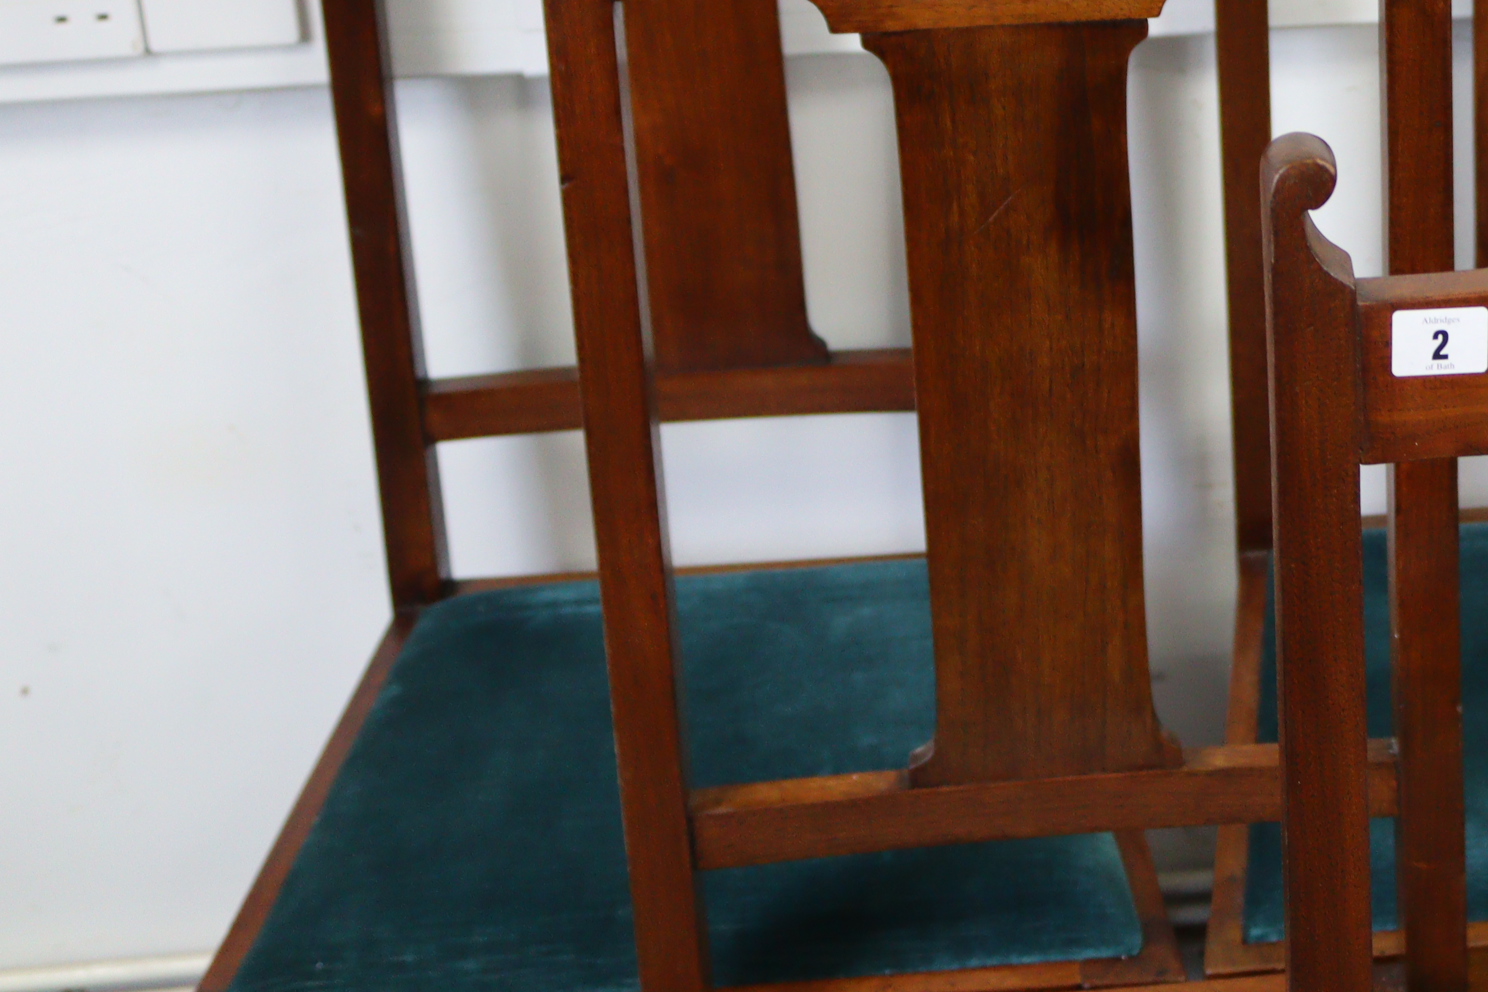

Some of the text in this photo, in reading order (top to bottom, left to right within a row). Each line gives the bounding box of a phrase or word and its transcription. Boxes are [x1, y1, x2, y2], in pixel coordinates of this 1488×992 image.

[1422, 316, 1460, 325] Aldridges
[1432, 329, 1449, 360] 2
[1436, 362, 1455, 370] Bath
